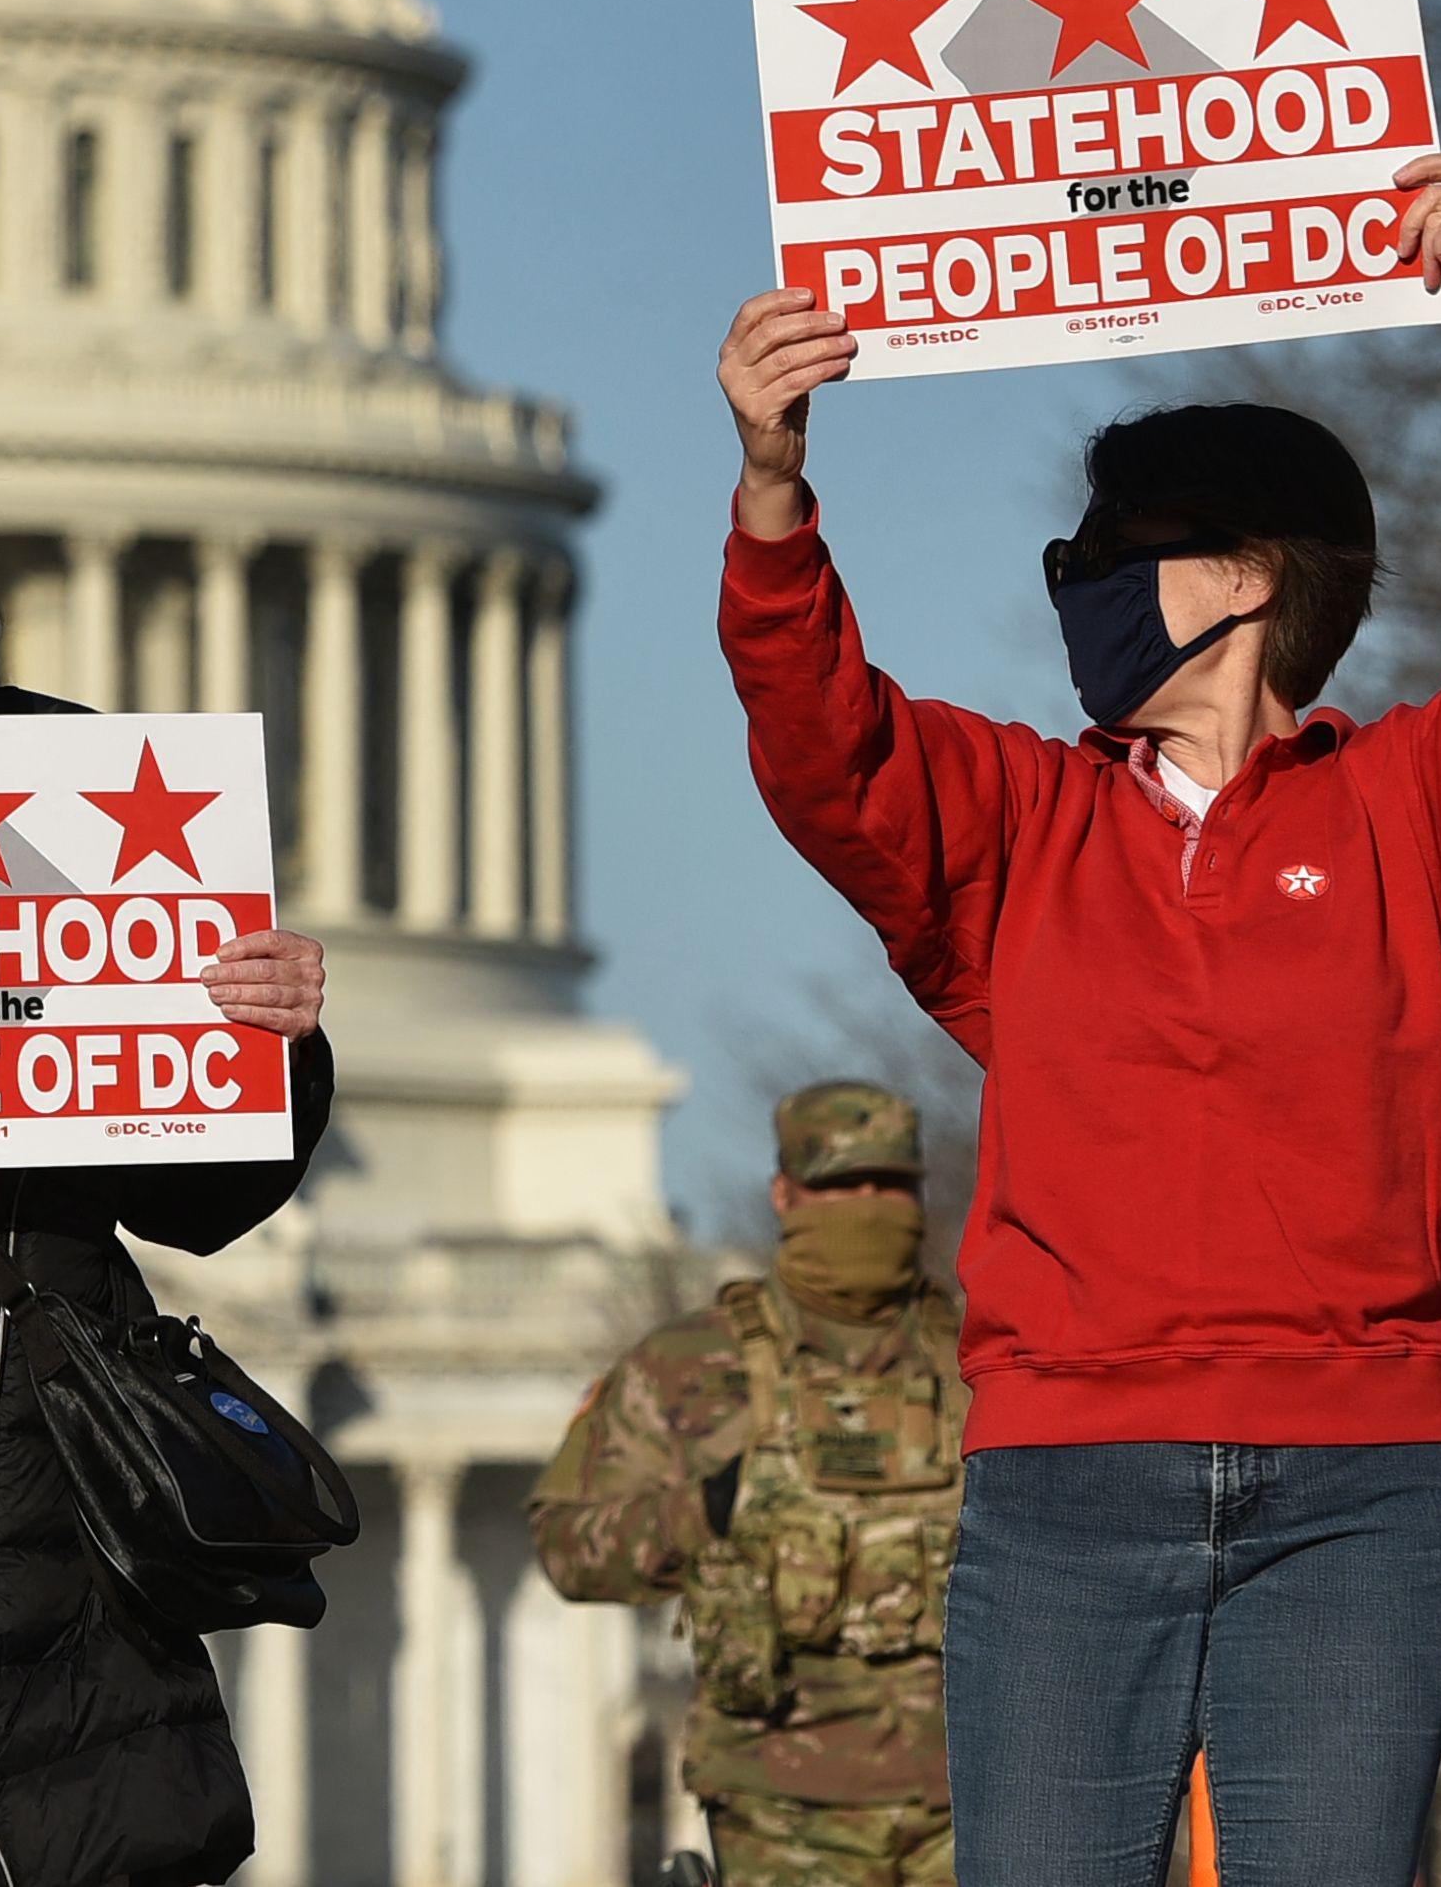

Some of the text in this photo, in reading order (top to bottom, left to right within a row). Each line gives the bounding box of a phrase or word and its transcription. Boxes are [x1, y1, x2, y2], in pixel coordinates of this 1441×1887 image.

[819, 65, 1391, 197] STATEHOOD
[1067, 175, 1190, 213] for the
[823, 198, 1399, 322] PEOPLE OF DC
[886, 289, 1364, 350] @51stDC @51for51 @DC_Vote
[17, 1033, 122, 1113] OF
[137, 1030, 242, 1111] DC
[104, 1120, 206, 1137] @DC_Vote
